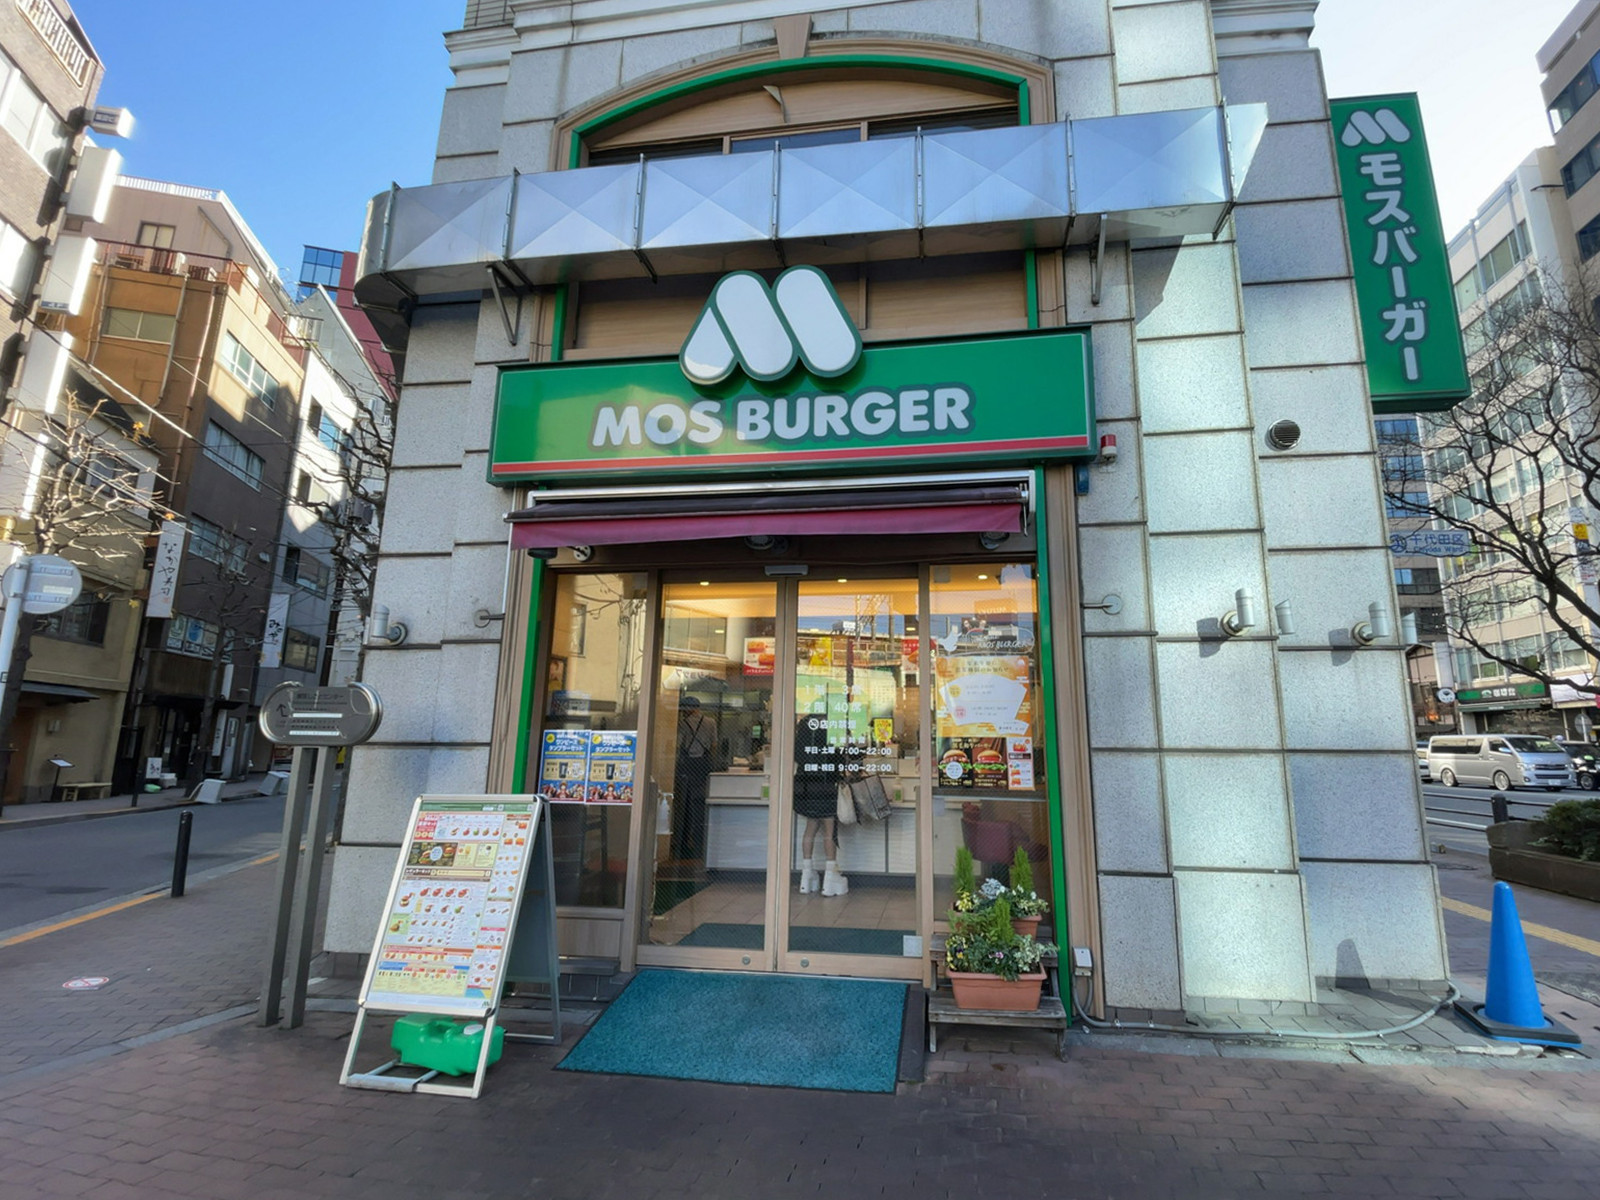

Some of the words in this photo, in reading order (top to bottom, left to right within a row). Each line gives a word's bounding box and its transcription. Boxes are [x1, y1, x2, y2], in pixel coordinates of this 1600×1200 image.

[1360, 152, 1426, 381] モスバーガー
[592, 400, 723, 448] MOS
[736, 387, 970, 442] BURGER
[1410, 533, 1465, 545] 千代田区
